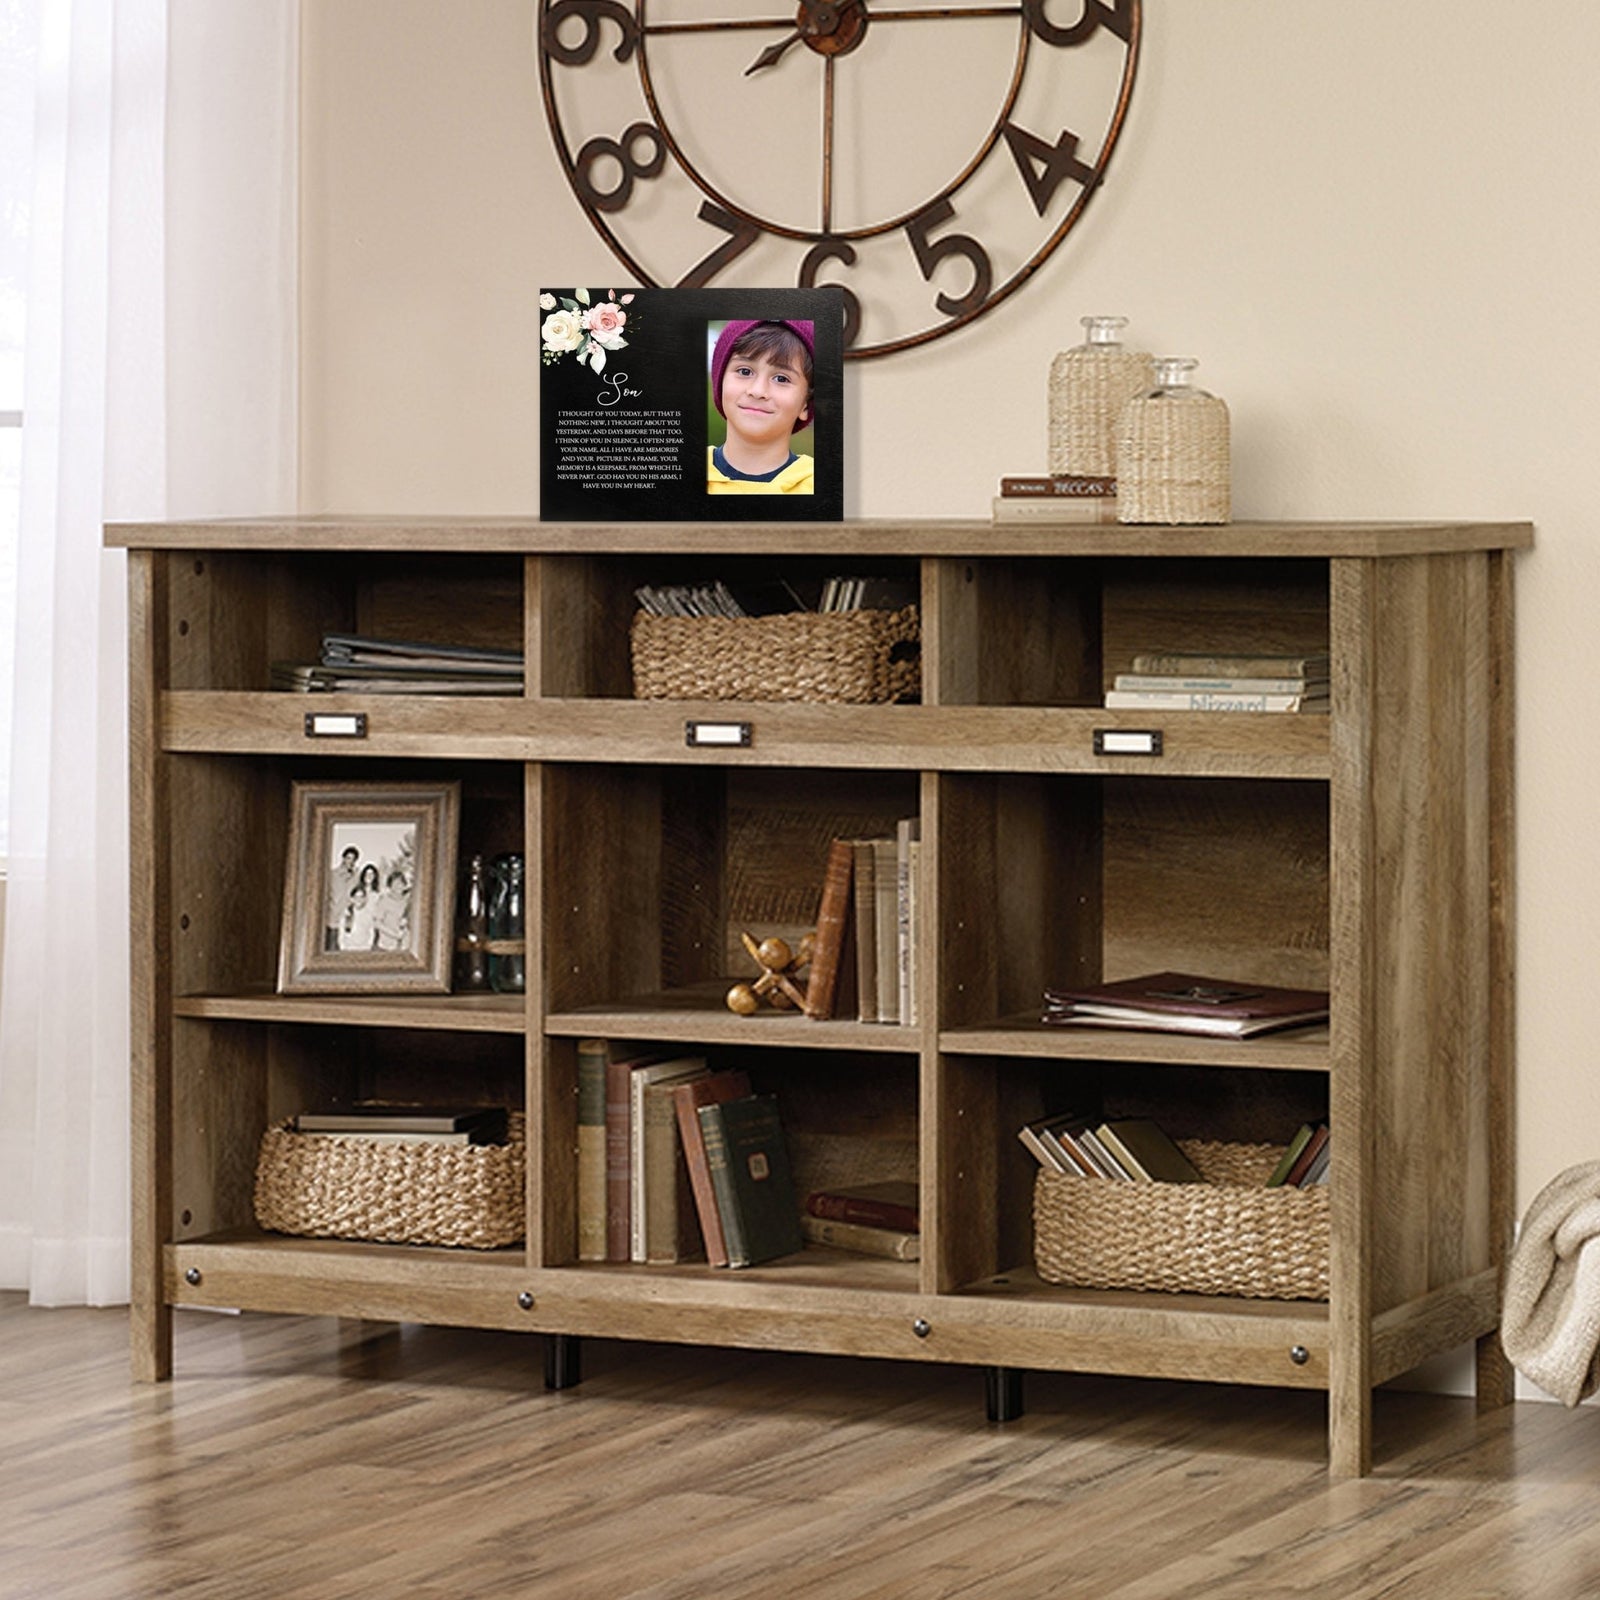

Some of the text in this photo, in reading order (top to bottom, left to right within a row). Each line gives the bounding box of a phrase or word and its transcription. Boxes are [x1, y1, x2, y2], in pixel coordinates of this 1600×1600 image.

[575, 121, 667, 213] 8
[1003, 120, 1103, 217] 4
[679, 200, 762, 289] 7
[904, 200, 992, 317] 5
[596, 372, 643, 406] Son
